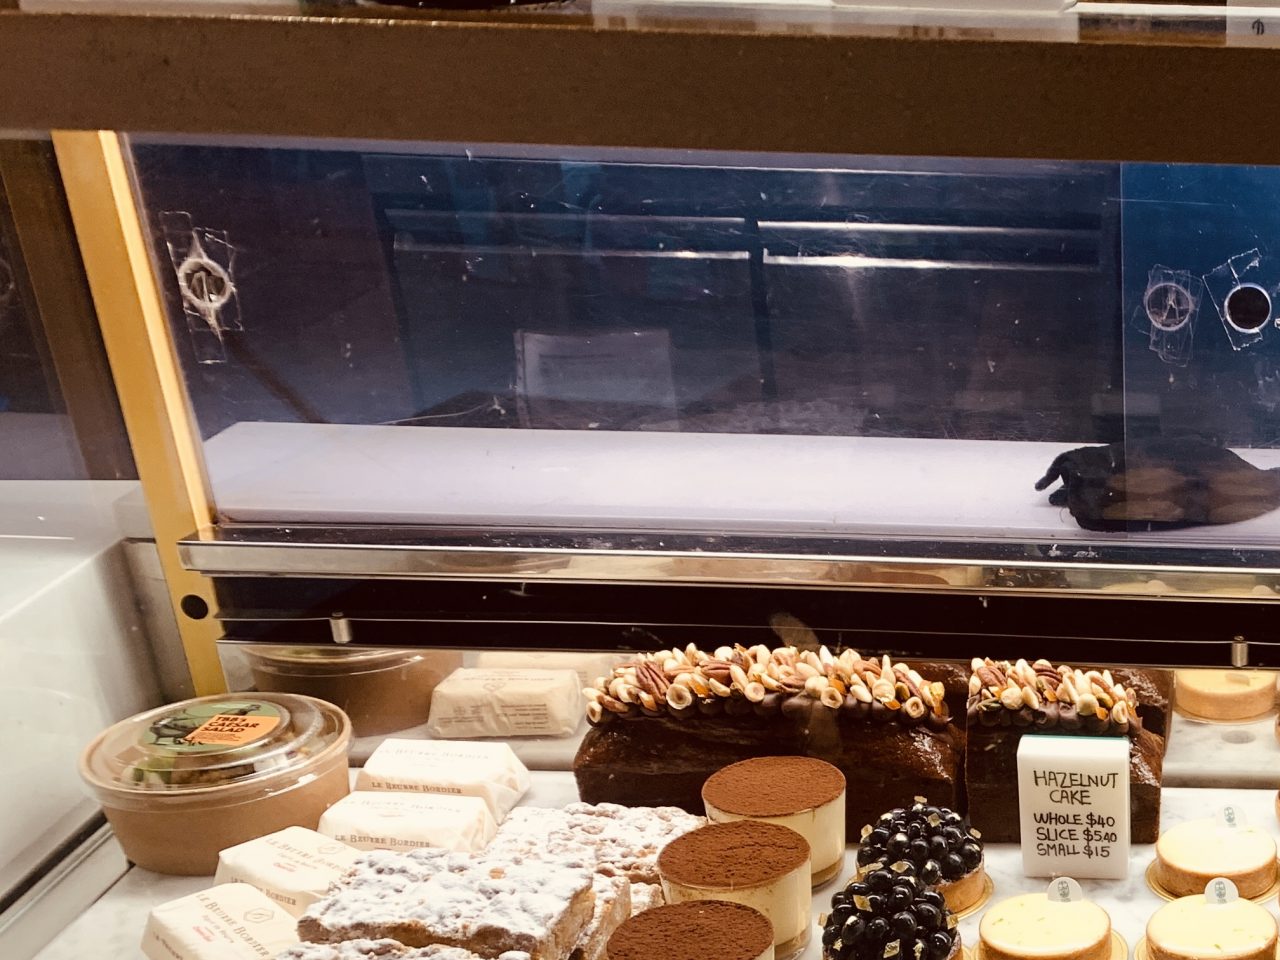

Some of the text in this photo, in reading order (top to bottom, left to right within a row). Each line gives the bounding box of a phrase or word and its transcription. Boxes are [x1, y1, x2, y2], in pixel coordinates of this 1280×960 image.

[1033, 770, 1119, 789] HAZELNUT
[1050, 789, 1092, 805] CAKE
[1034, 812, 1116, 828] WHOLE $40
[1036, 827, 1080, 842] SLICE
[1037, 842, 1111, 859] SMALL $15
